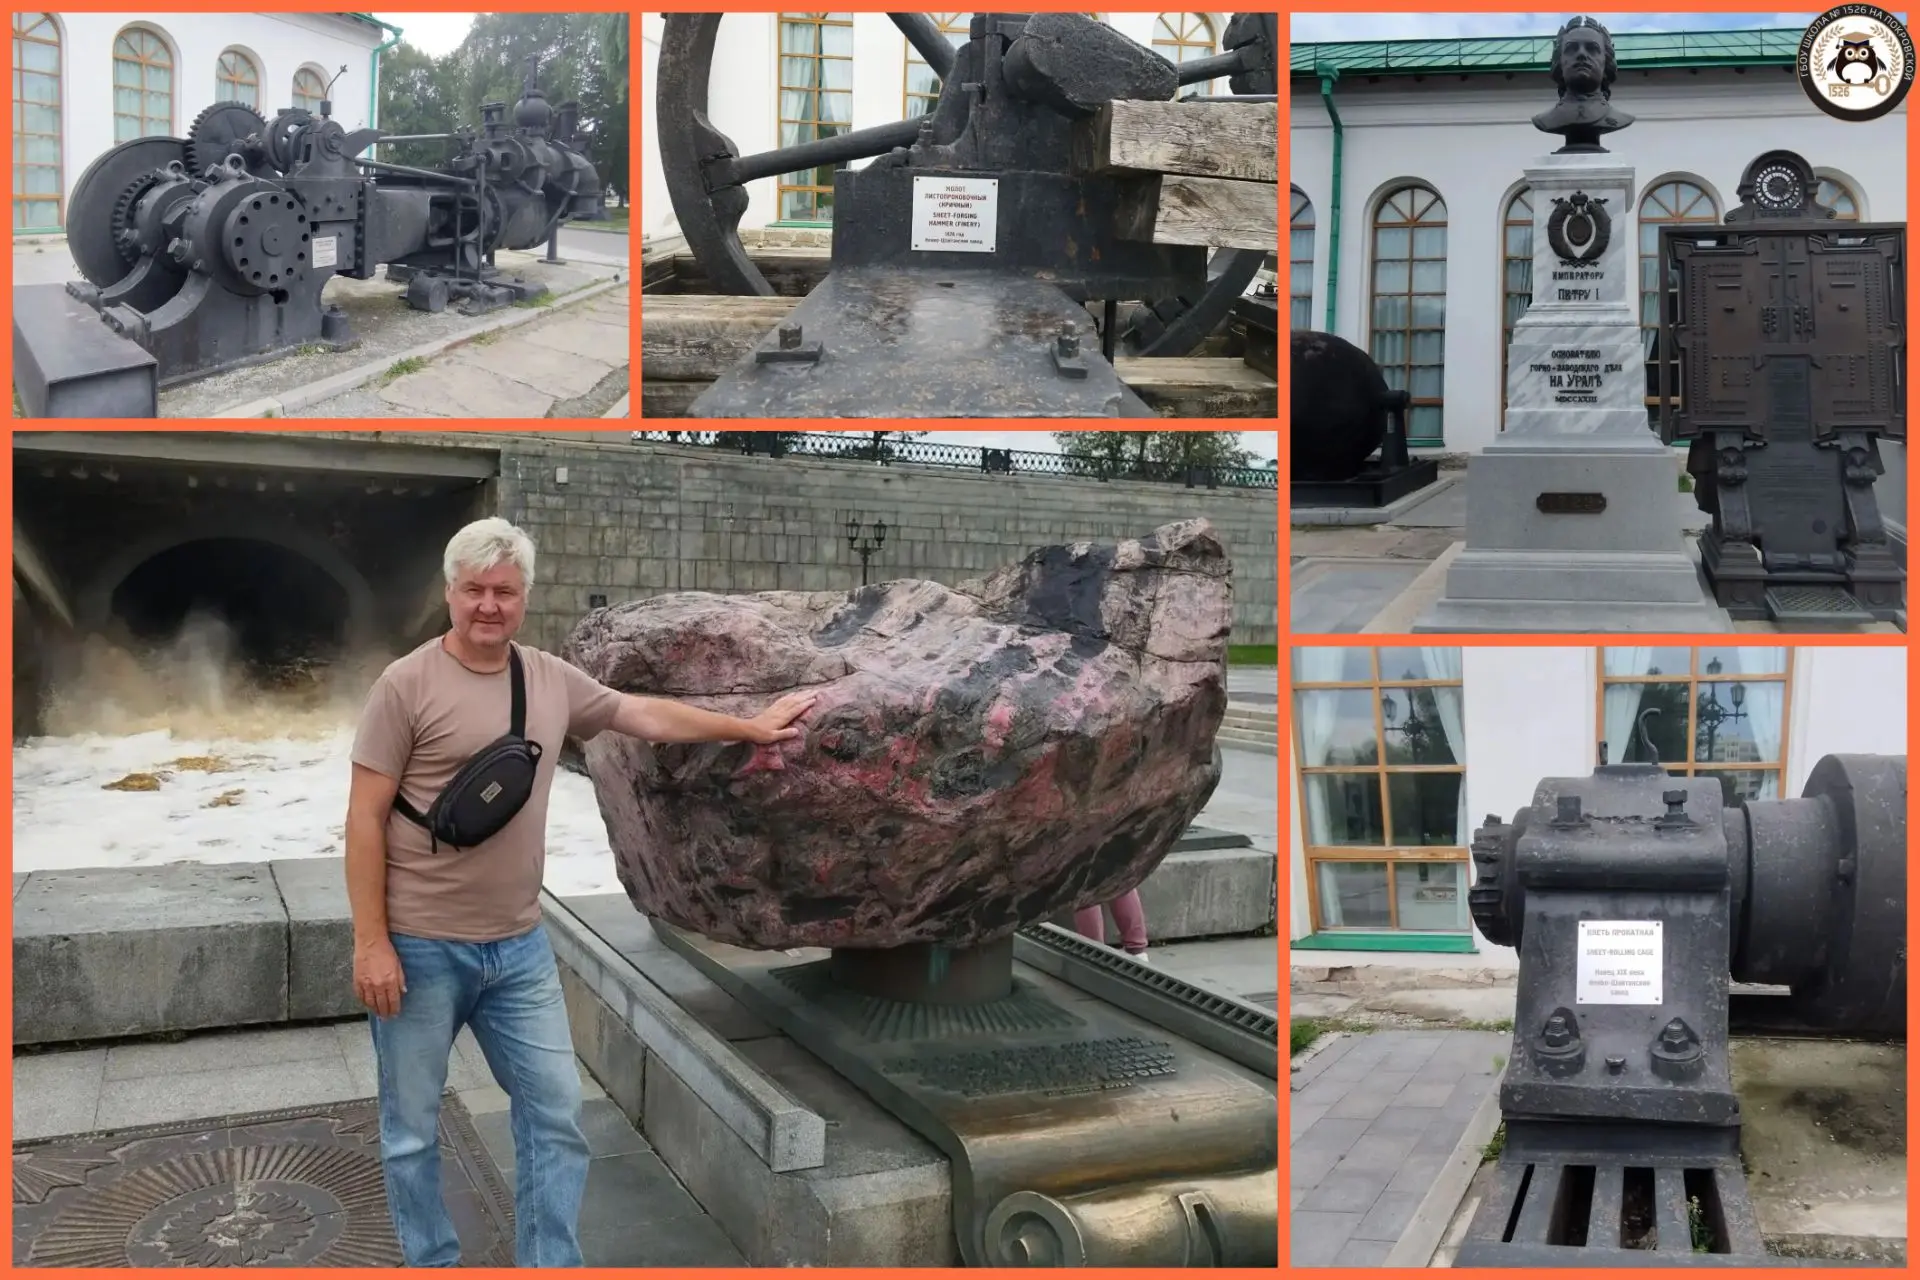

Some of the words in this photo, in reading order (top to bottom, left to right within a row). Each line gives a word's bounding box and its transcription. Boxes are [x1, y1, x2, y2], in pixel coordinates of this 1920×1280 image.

[1552, 271, 1605, 280] ИМПЕРАТОРУ
[1558, 288, 1591, 300] ПЕТРУ
[1550, 376, 1563, 388] НА
